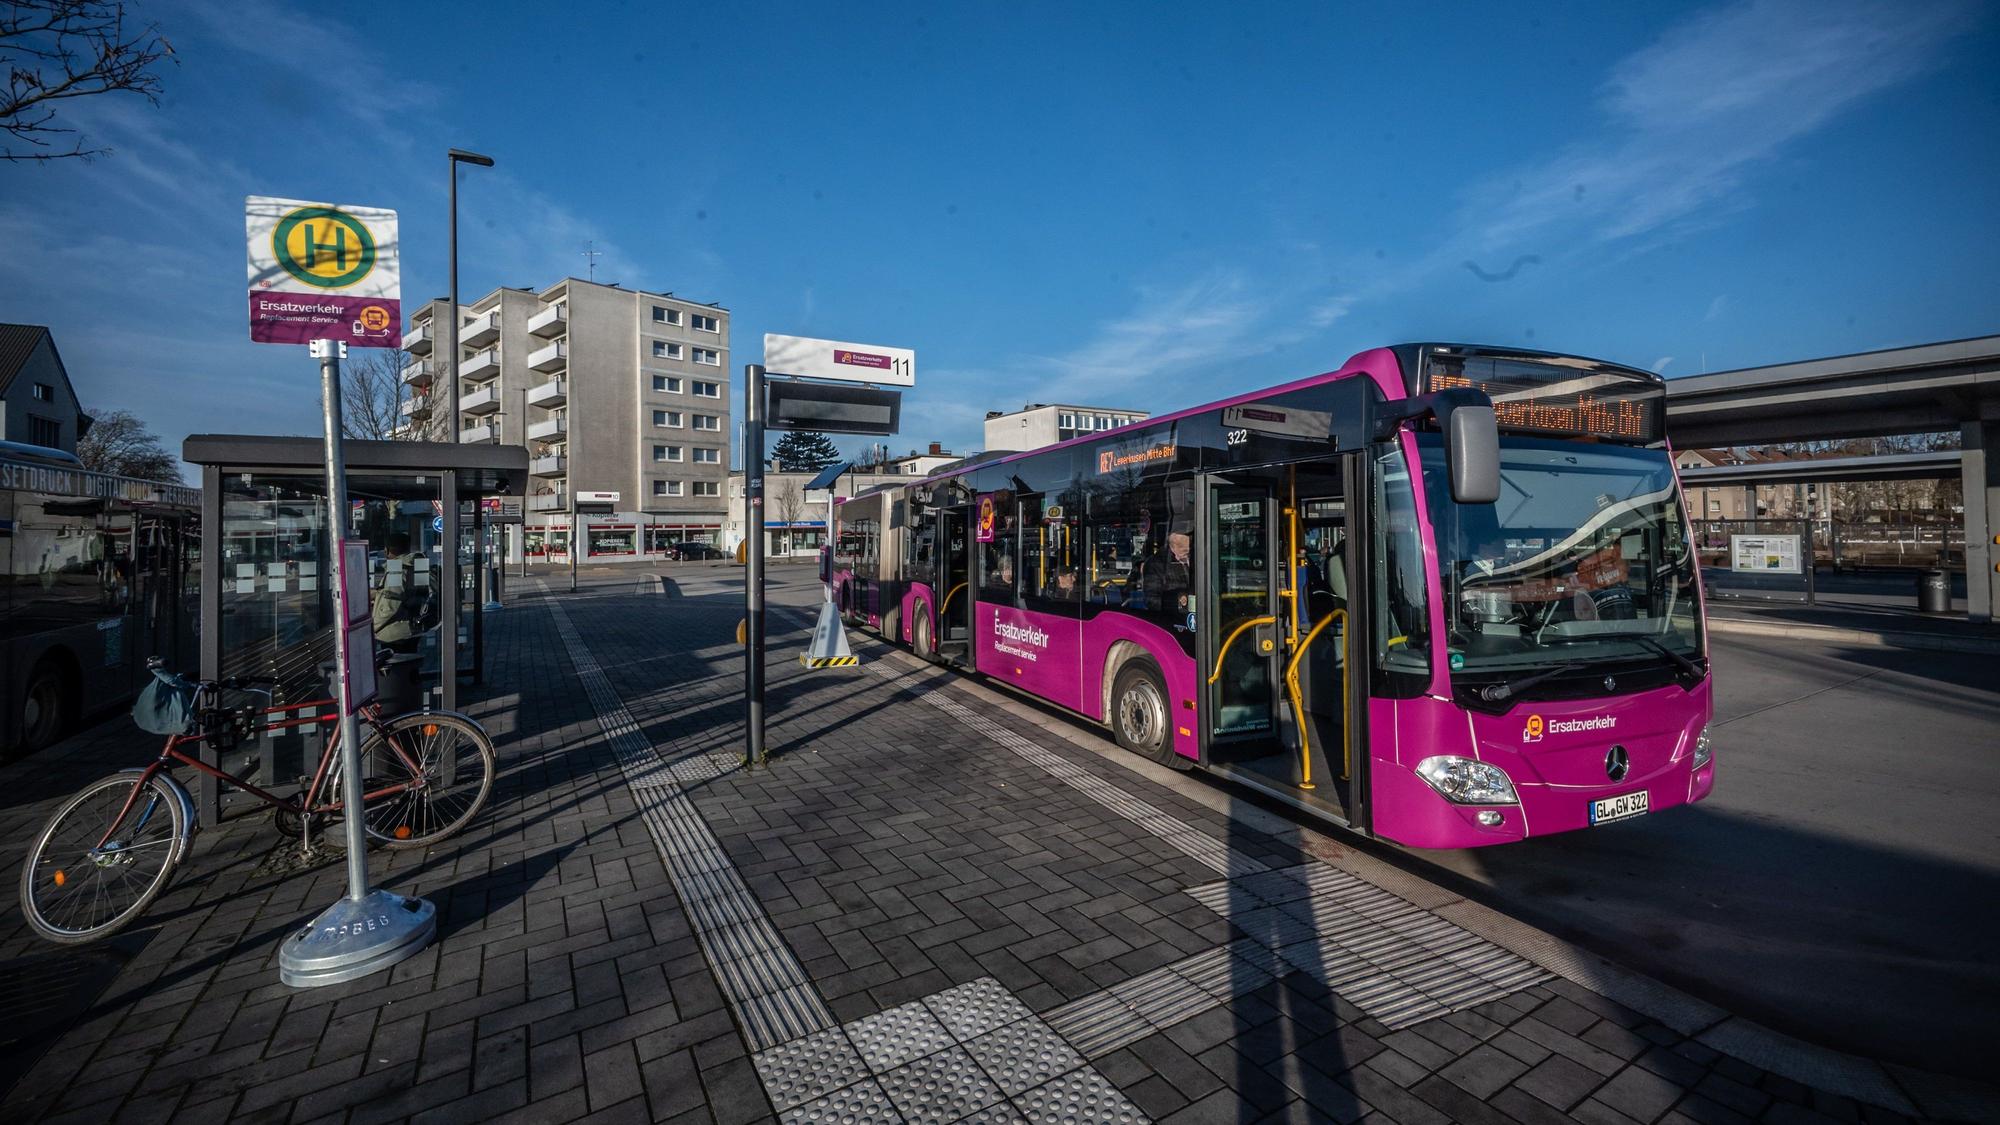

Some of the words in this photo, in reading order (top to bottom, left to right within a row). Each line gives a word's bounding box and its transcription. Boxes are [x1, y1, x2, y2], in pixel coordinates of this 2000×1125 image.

[304, 223, 346, 271] H
[259, 300, 345, 315] Ersatzverkehr
[259, 313, 310, 323] Replacement
[311, 316, 339, 324] Service
[852, 353, 883, 363] Ersatzverkehr
[892, 357, 910, 377] 11
[1578, 394, 1616, 433] Mitte
[1618, 399, 1644, 436] Bhf
[1227, 429, 1247, 445] 322
[1100, 451, 1114, 473] RE7
[1114, 453, 1146, 466] Leverkusen
[1146, 448, 1163, 460] Mitte
[1163, 444, 1175, 457] Bhf
[995, 618, 1049, 648] Ersatzverkehr
[994, 640, 1021, 657] Replacement
[1020, 650, 1037, 662] service
[1549, 714, 1617, 733] Ersatzverkehr
[1596, 802, 1611, 819] GL
[1616, 796, 1629, 814] GW
[1630, 793, 1647, 811] 322
